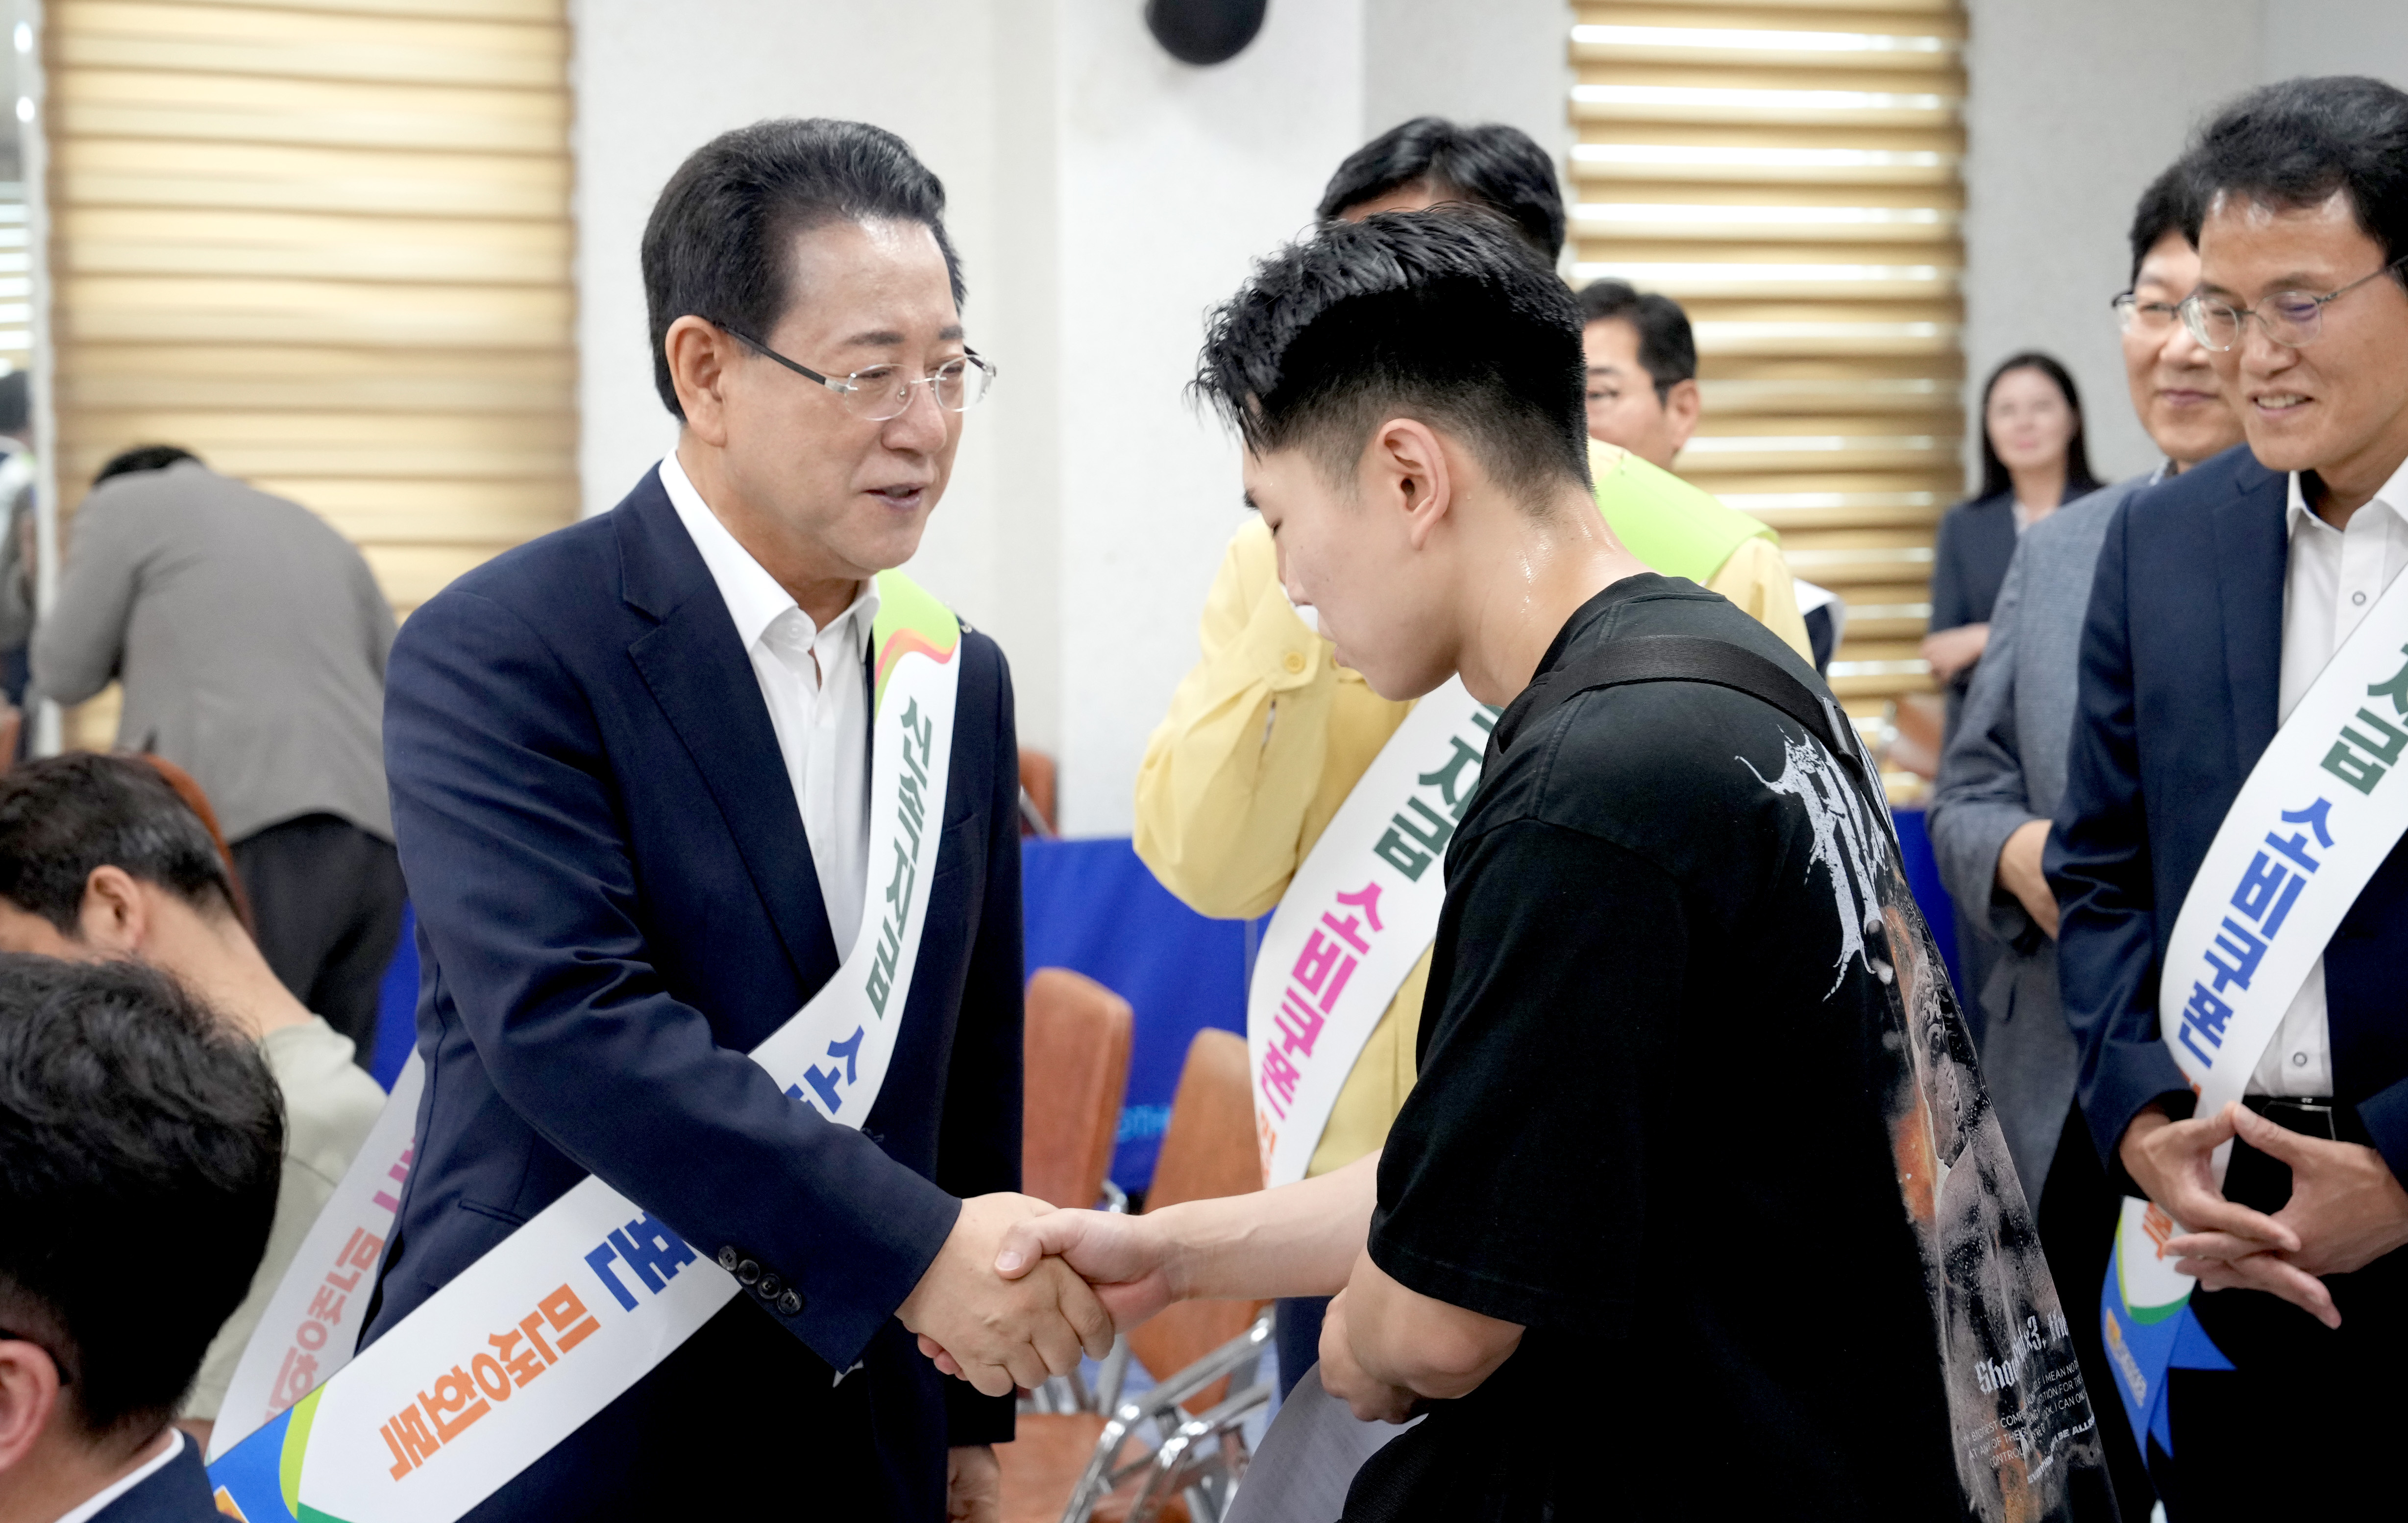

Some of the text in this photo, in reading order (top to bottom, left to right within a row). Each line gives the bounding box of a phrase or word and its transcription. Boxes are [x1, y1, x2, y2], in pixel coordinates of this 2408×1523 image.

[2179, 797, 2334, 1068] 소비쿠폰
[1261, 882, 1384, 1120] 소비쿠폰
[380, 1283, 601, 1481] 민생회복
[2045, 1367, 2066, 1383] MEAN
[2058, 1380, 2074, 1395] FOR
[2058, 1395, 2075, 1410] CAN
